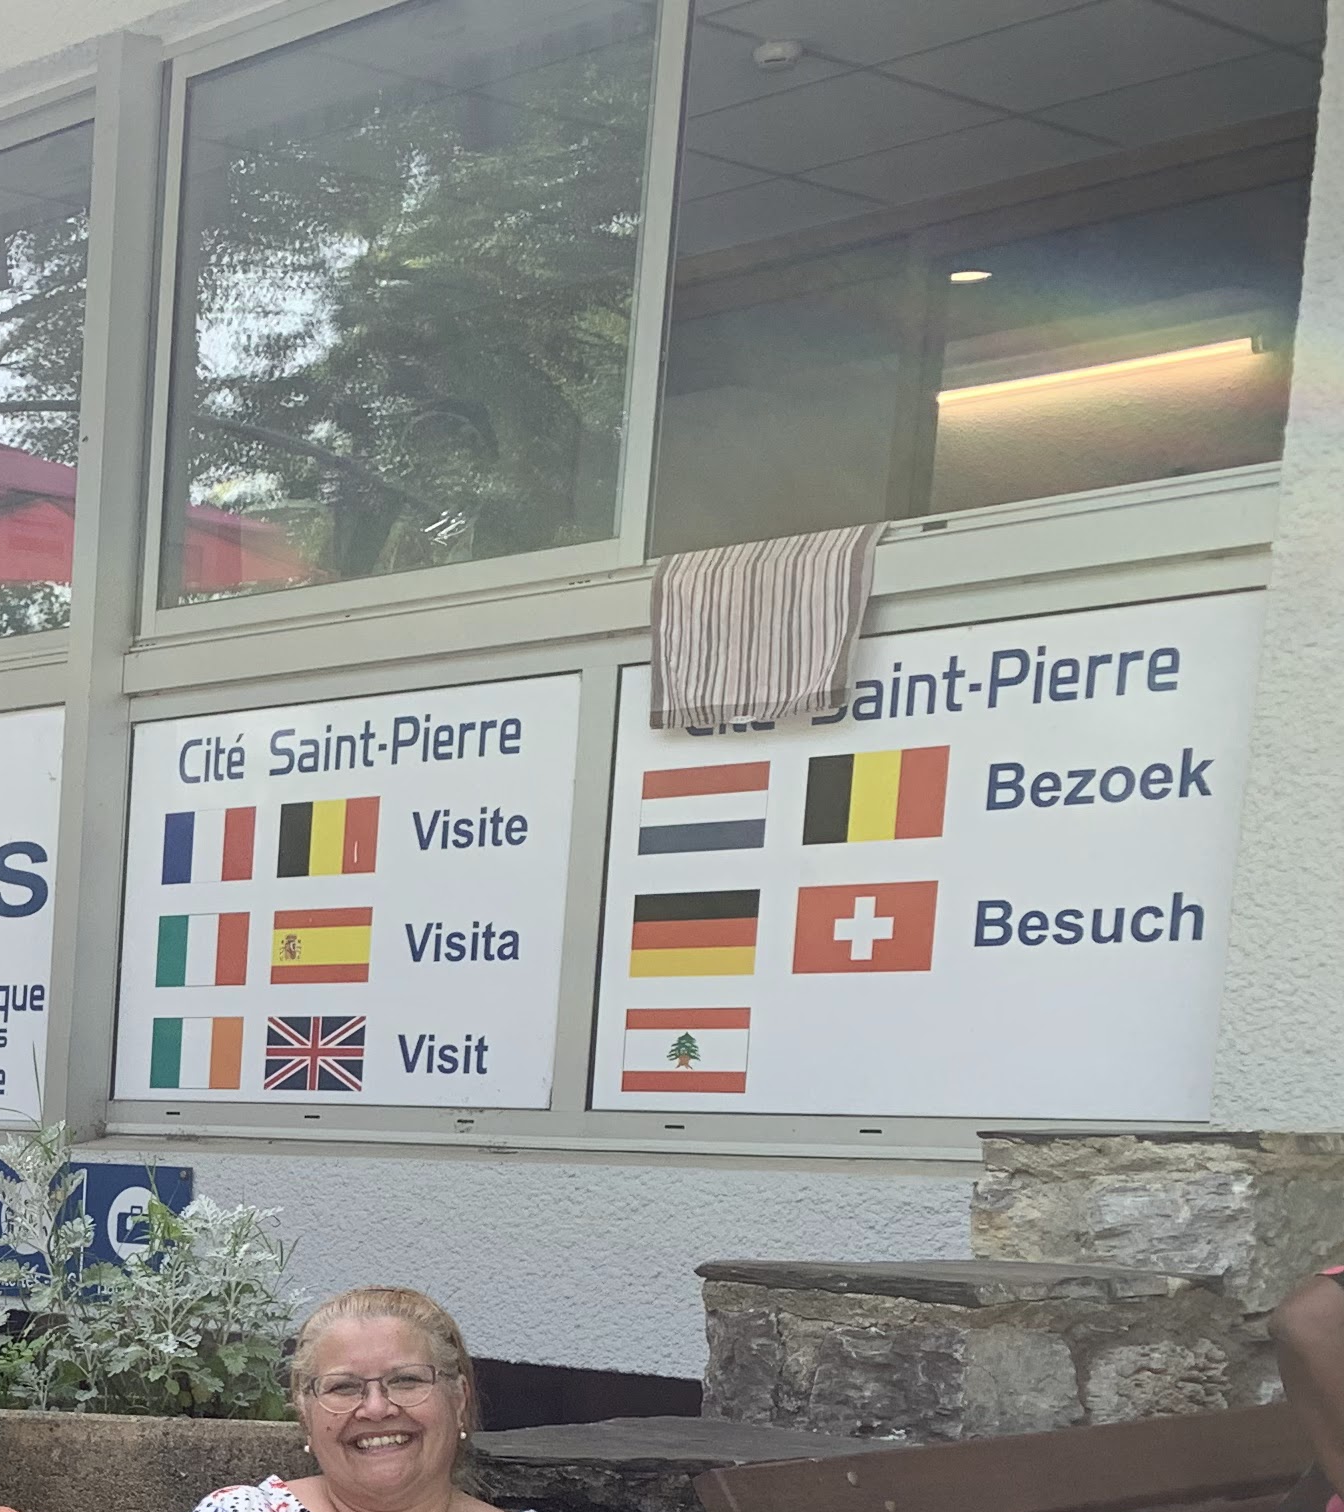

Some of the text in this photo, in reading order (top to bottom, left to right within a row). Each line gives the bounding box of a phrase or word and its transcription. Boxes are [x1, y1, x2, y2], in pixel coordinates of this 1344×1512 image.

[812, 646, 1180, 725] aint-Pierre
[179, 714, 521, 783] Cité Saint-Pierre
[985, 747, 1215, 811] Bezoek
[413, 807, 528, 851] Visite
[406, 922, 519, 962] Visita
[974, 892, 1204, 947] Besuch
[398, 1034, 488, 1074] Visit
